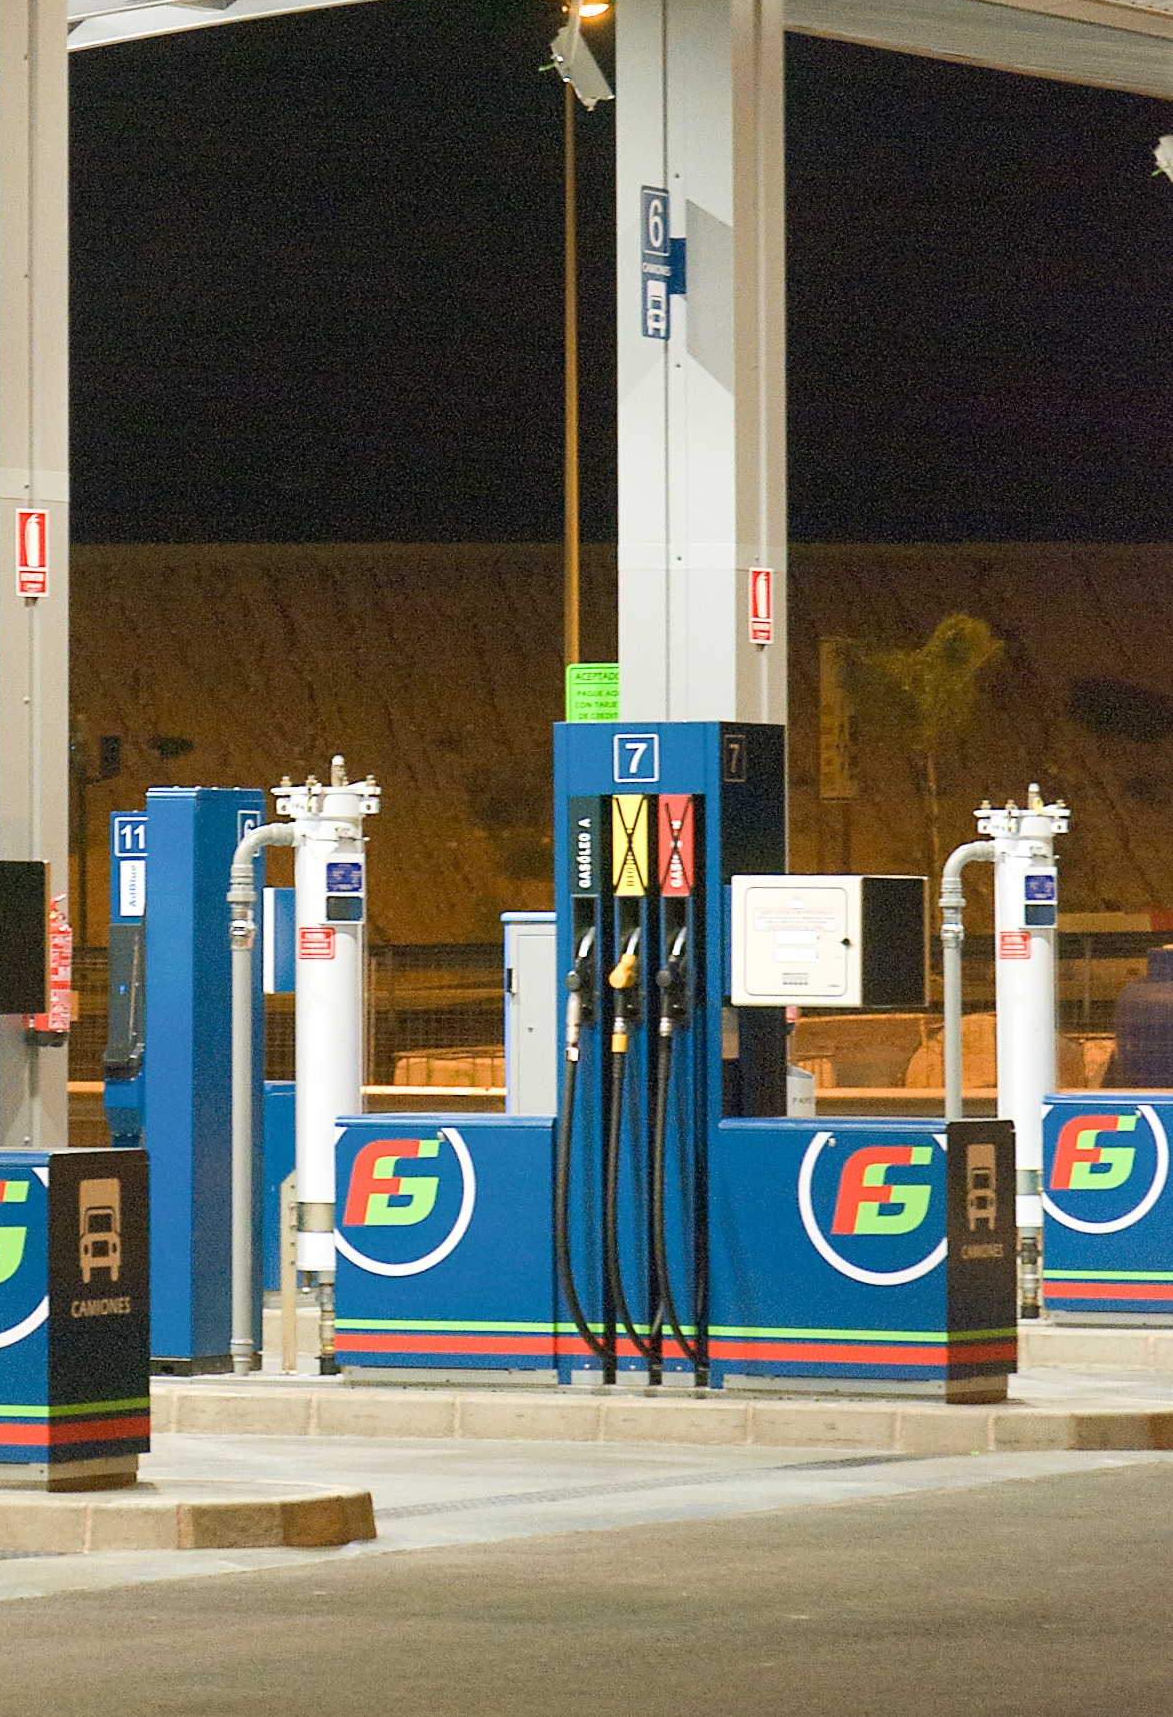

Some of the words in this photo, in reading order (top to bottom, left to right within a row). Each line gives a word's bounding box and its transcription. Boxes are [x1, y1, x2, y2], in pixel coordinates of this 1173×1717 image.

[648, 198, 664, 249] 6
[625, 742, 648, 774] 7
[728, 742, 740, 773] 7
[120, 824, 146, 850] 11
[577, 817, 592, 828] A
[128, 864, 137, 908] AdBlue
